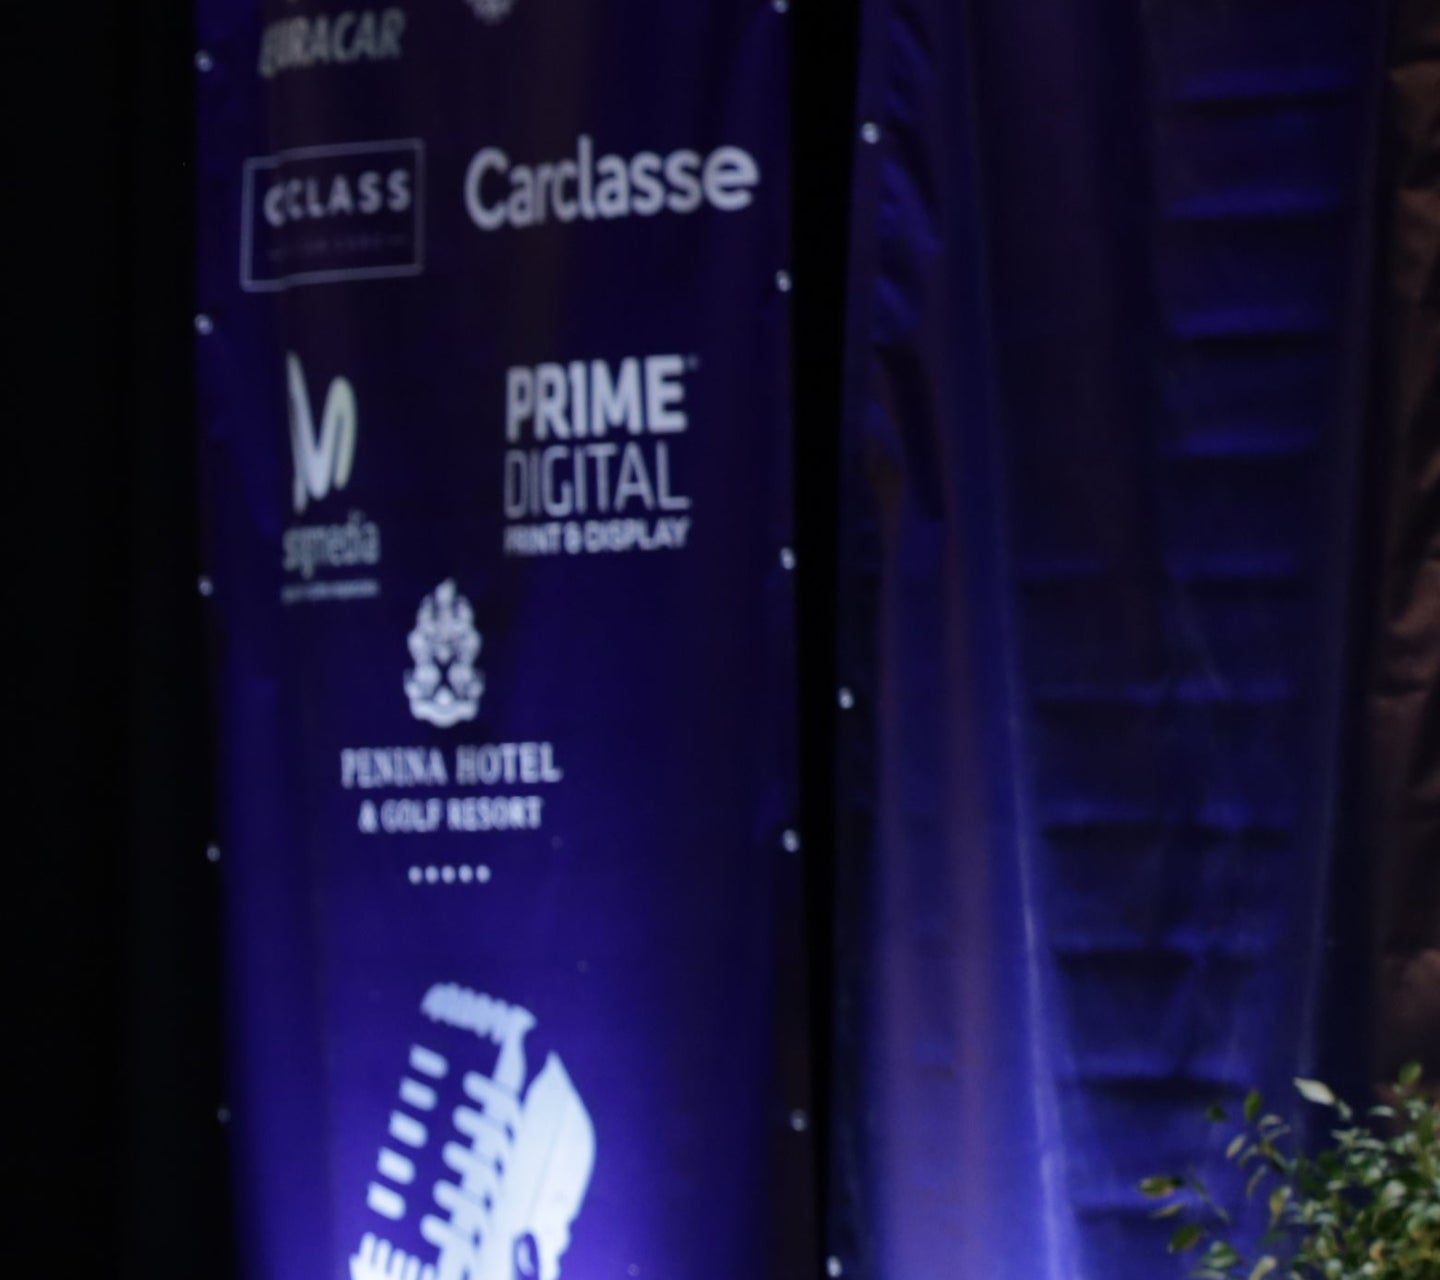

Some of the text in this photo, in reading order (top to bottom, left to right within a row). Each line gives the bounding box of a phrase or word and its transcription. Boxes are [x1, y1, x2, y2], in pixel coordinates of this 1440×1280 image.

[464, 133, 760, 231] Carclasse
[505, 354, 688, 443] PRIME
[504, 439, 692, 519] DIGITAL
[455, 741, 564, 785] HOTEL
